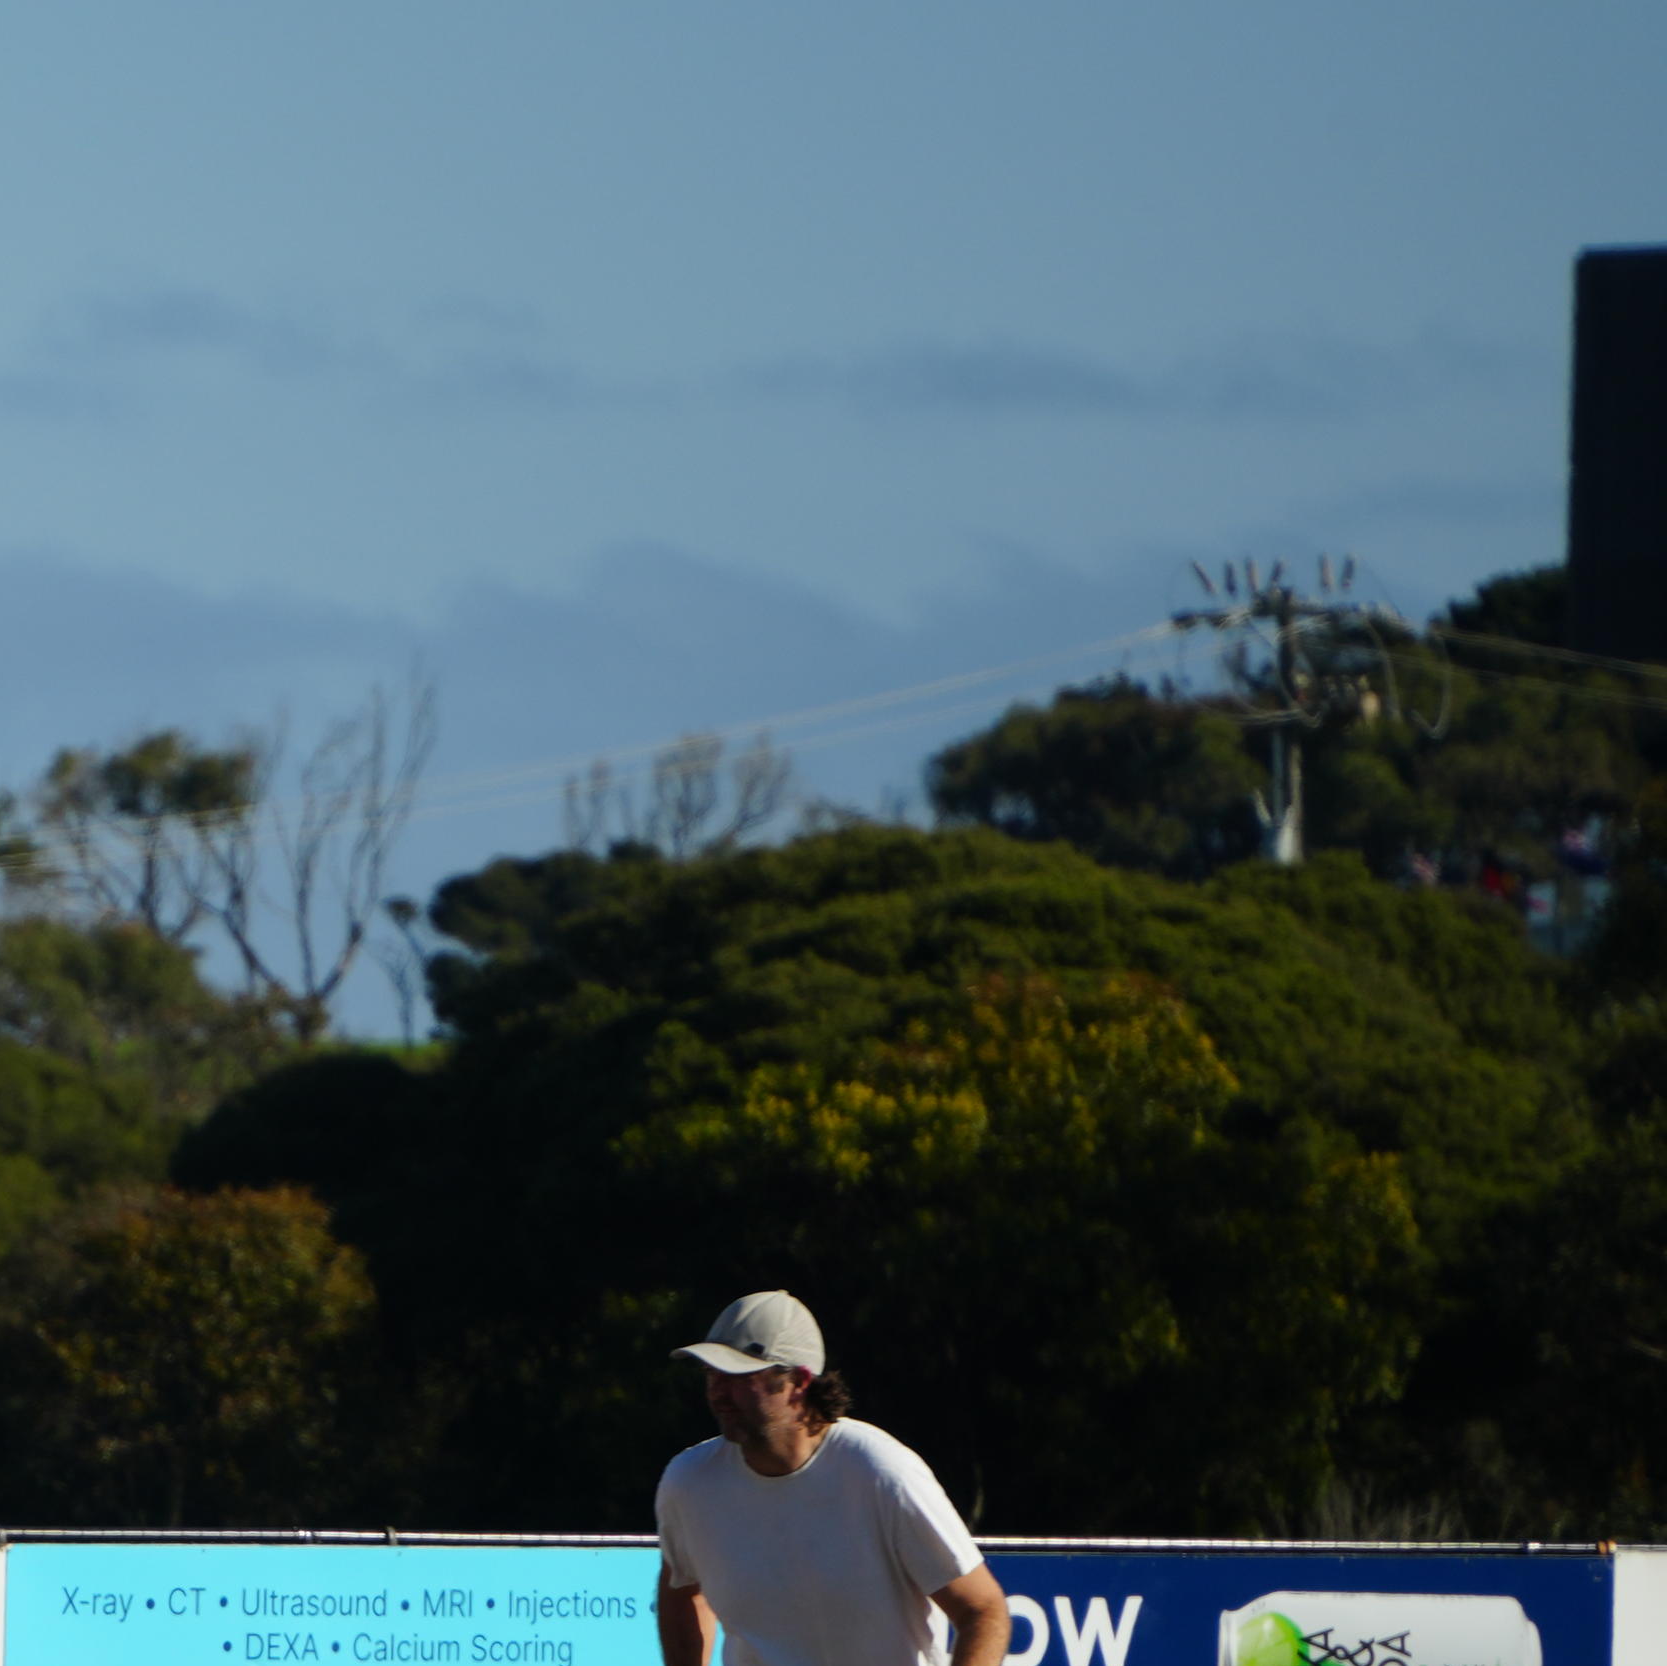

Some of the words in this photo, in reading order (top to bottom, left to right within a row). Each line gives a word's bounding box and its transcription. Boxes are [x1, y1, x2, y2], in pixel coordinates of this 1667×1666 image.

[63, 1587, 133, 1622] X-ray
[169, 1588, 206, 1615] CT
[243, 1589, 386, 1616] Ultrasound
[424, 1589, 472, 1617] MRI
[509, 1590, 636, 1625] Injections
[246, 1633, 318, 1660] DEXA
[354, 1633, 460, 1661] Calcium
